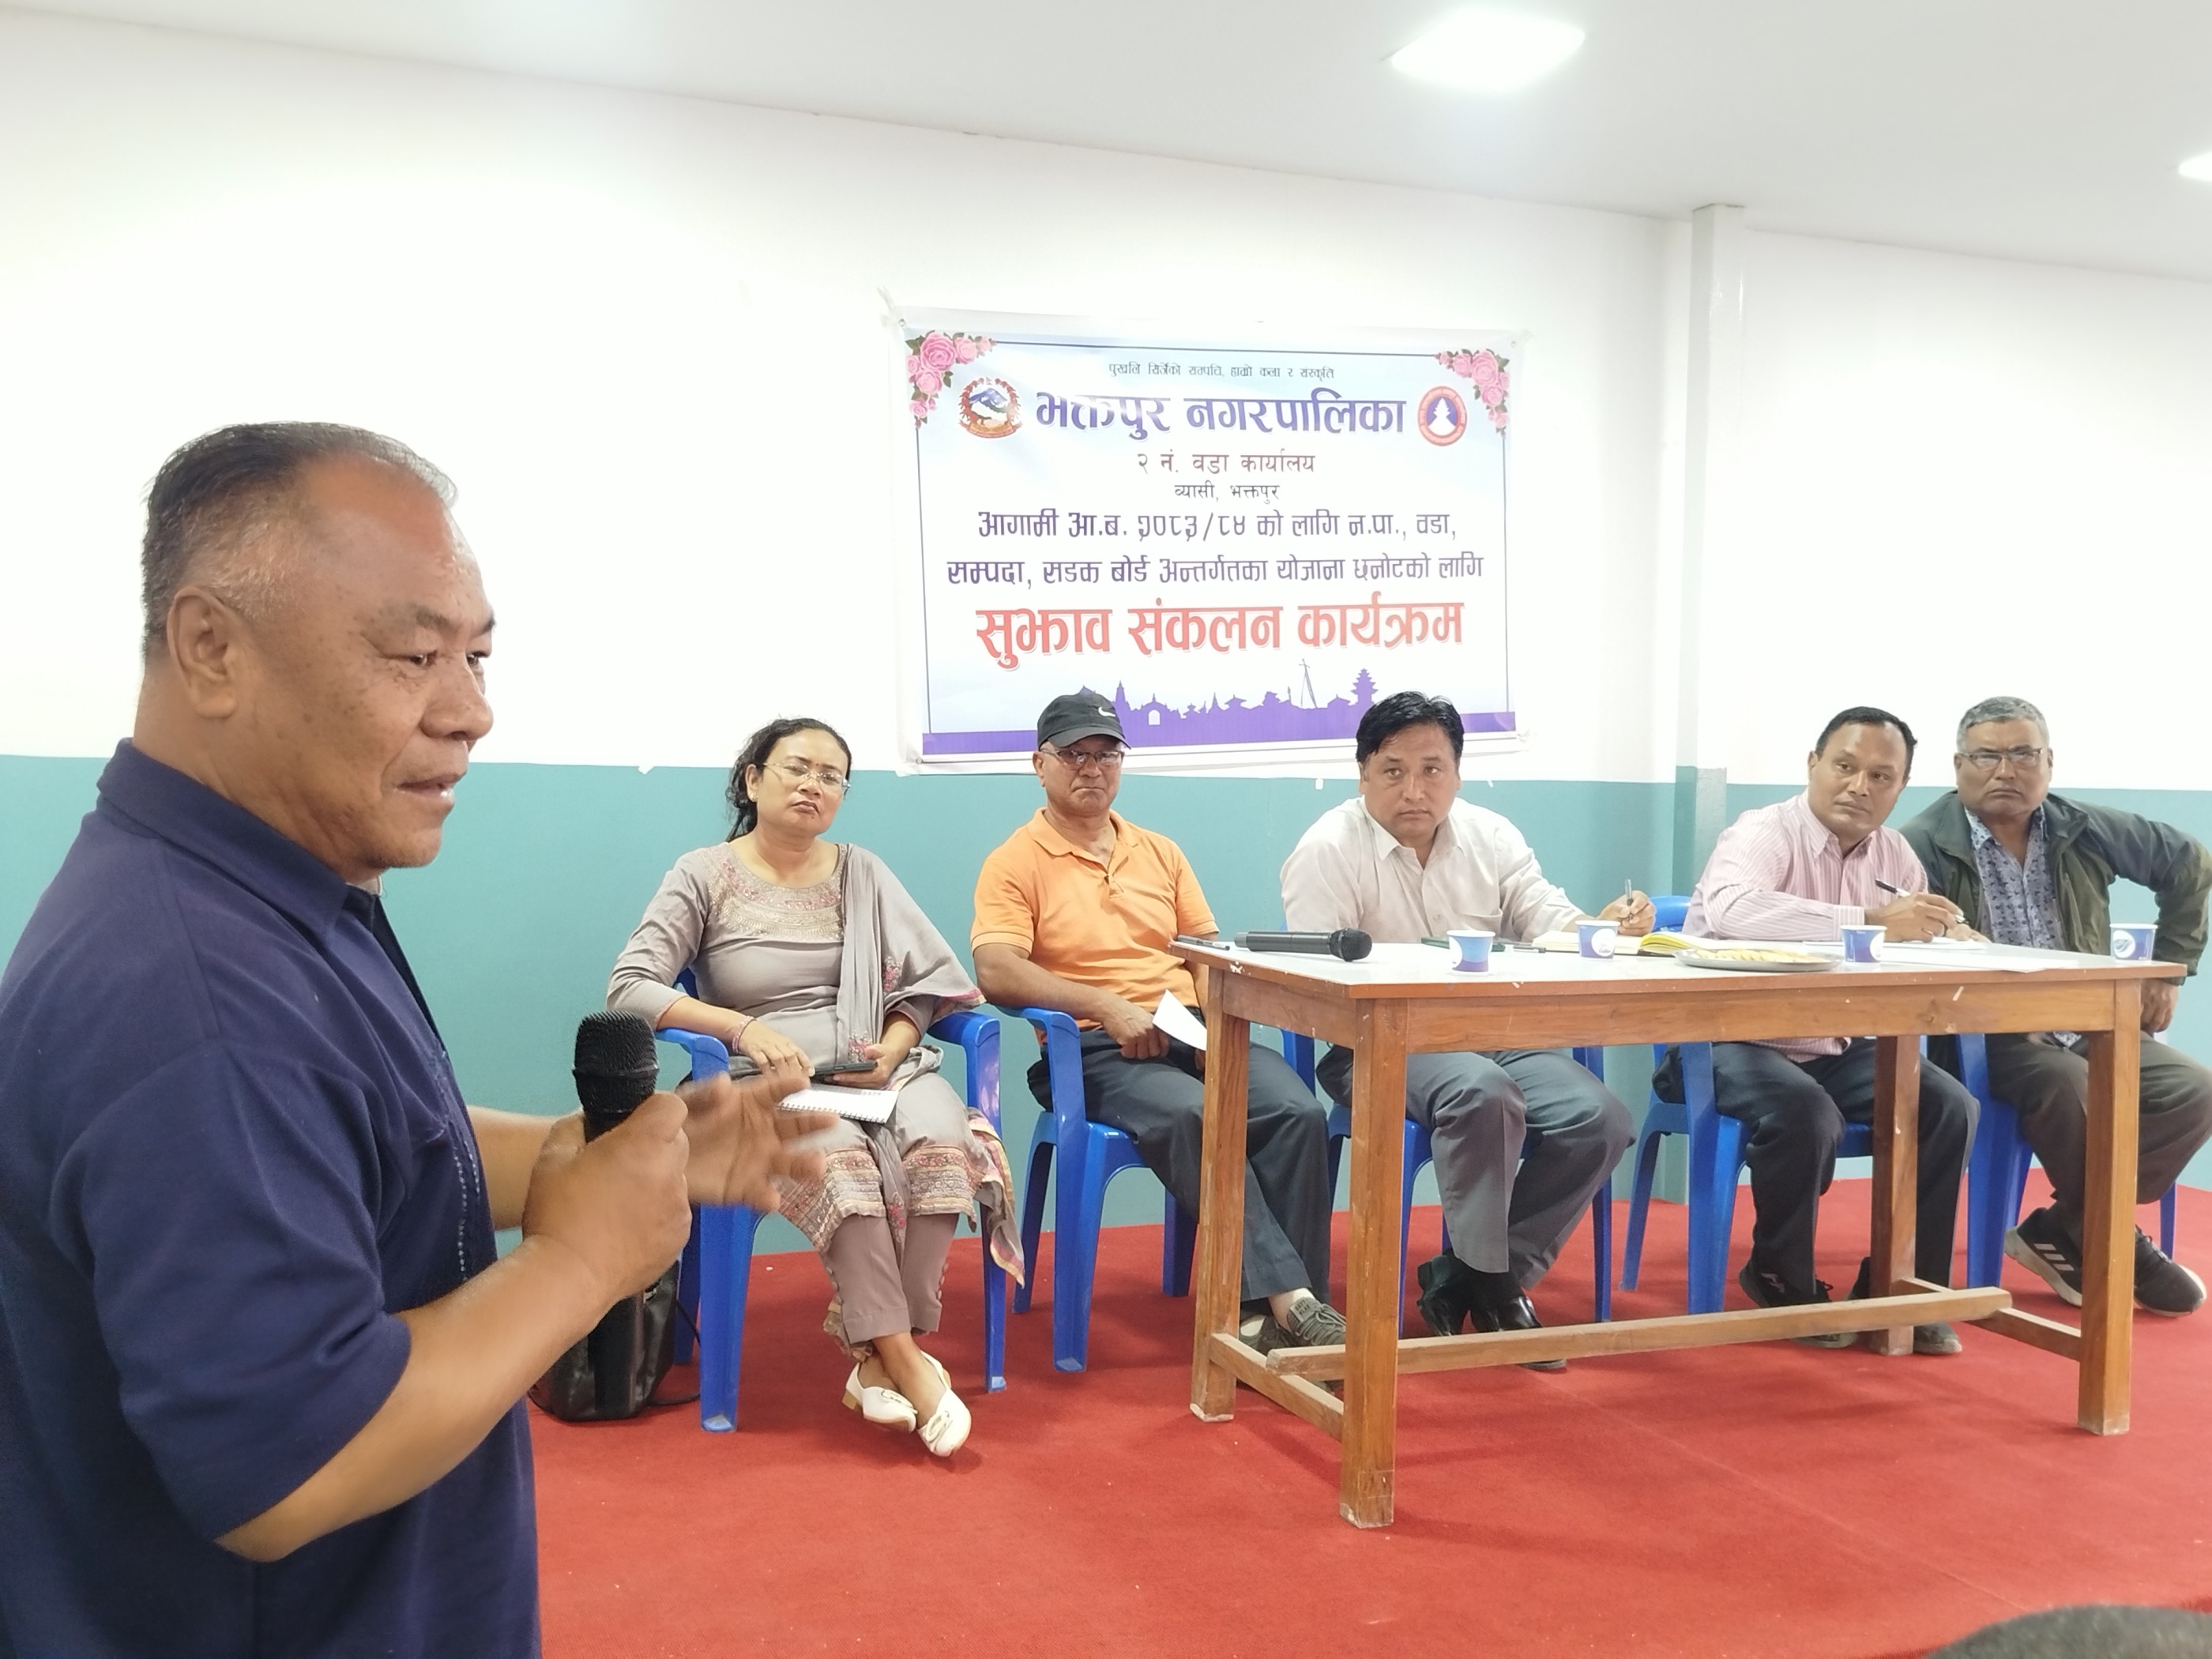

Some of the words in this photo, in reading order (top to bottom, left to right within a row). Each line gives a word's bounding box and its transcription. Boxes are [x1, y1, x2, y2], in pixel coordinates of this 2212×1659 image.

[1287, 367, 1294, 378] र
[1036, 391, 1171, 441] भक्तपुर
[1183, 386, 1408, 434] नगरपालिका
[1137, 453, 1148, 474] २
[1160, 449, 1179, 473] नं.
[1191, 453, 1230, 475] वडा
[1240, 448, 1316, 472] कार्यालय
[1173, 479, 1219, 502] व्यासी,
[1229, 484, 1281, 505] भक्तपुर
[977, 507, 1060, 538] आगामी
[1256, 509, 1285, 537] को
[1291, 508, 1341, 537] लागि
[1416, 514, 1456, 540] वडा,
[946, 561, 1032, 590] सम्पदा,
[1042, 561, 1103, 585] सडक
[1110, 554, 1151, 582] बोर्ड
[1159, 554, 1269, 584] अन्तर्गतका
[1352, 551, 1432, 581] छनोटको
[1438, 551, 1484, 579] लागि
[975, 608, 1113, 672] सुझाव
[1127, 596, 1284, 656] संकलन
[1297, 590, 1465, 649] कार्यक्रम
